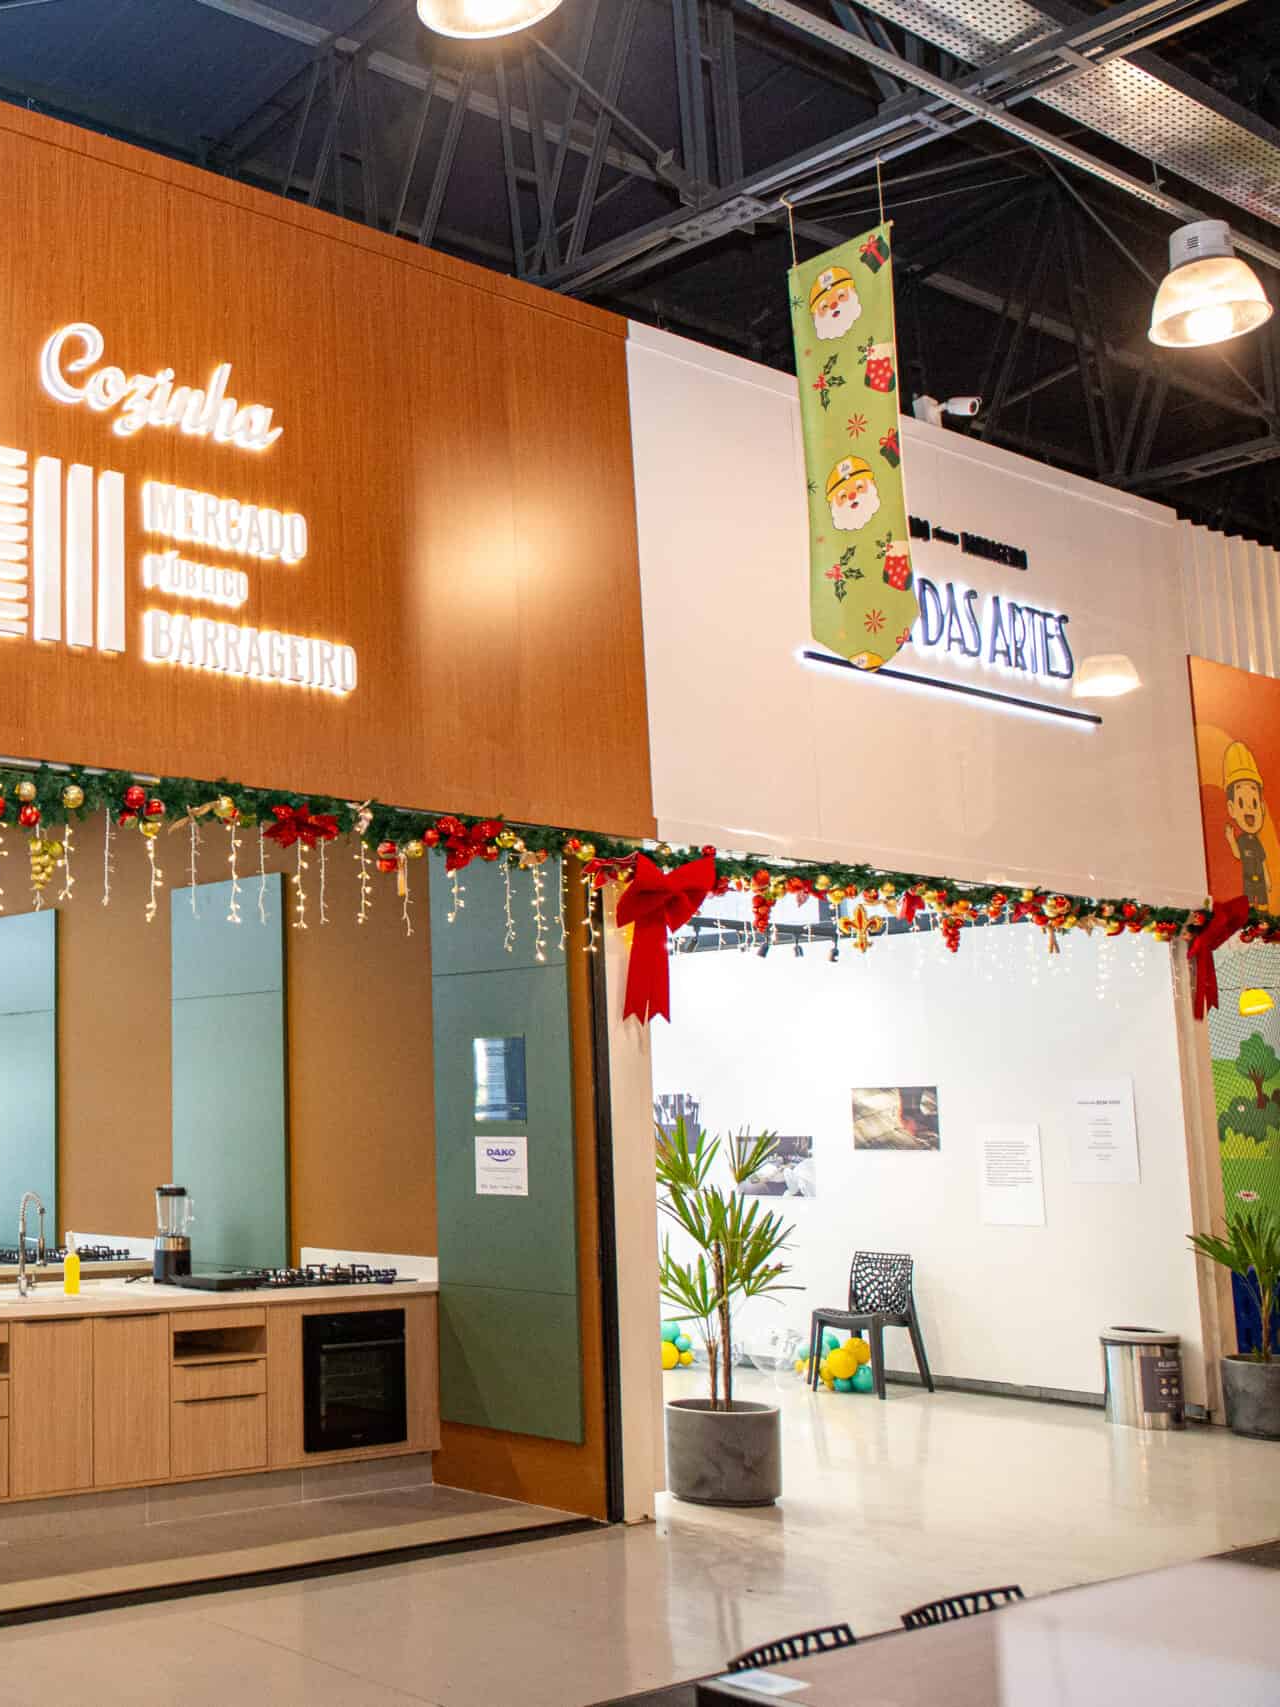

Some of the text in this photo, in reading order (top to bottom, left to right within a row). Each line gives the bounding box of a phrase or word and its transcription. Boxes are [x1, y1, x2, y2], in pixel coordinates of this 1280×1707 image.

[40, 323, 283, 450] Cozinha
[144, 481, 308, 563] MERCADO
[144, 550, 249, 607] PÚBLICO
[144, 610, 357, 694] BARRAGEIRO
[917, 577, 1074, 680] DAS ARTES
[486, 1148, 516, 1157] DAKO
